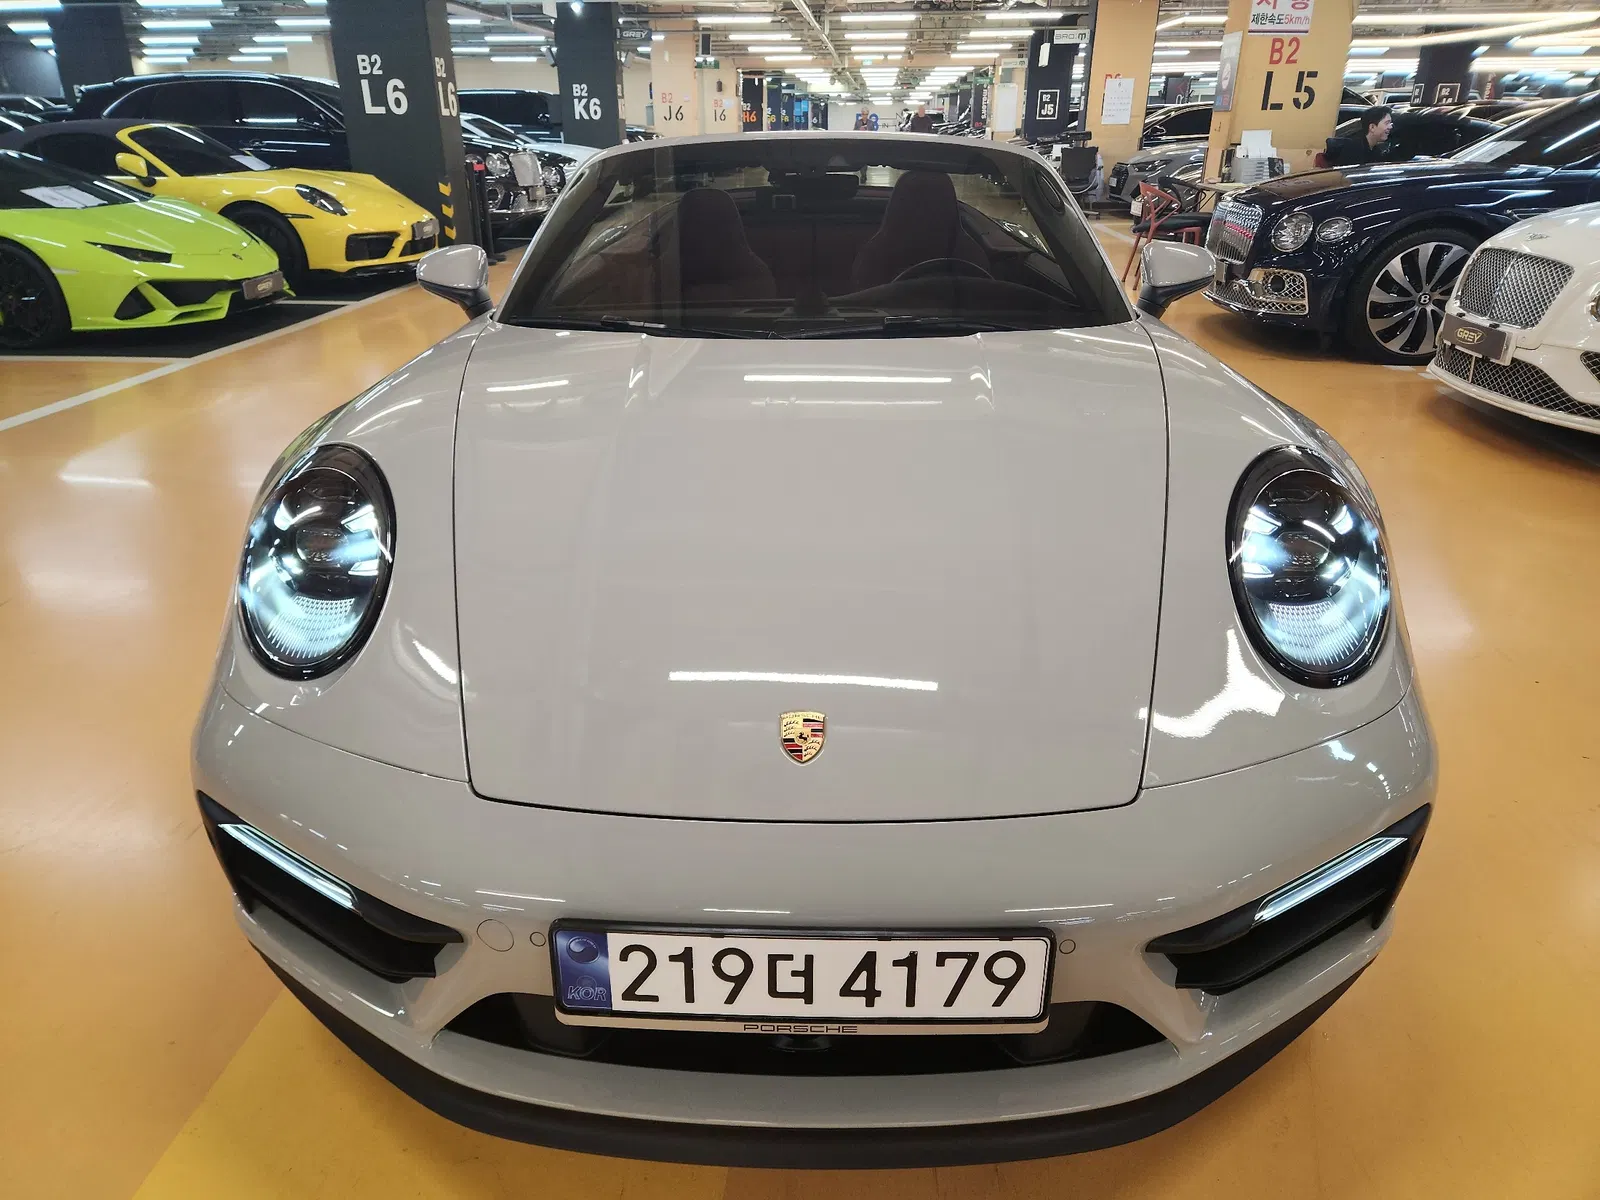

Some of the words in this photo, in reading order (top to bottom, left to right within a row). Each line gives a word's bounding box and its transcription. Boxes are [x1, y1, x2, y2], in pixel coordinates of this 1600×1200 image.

[622, 30, 648, 38] GREY
[1269, 37, 1301, 65] B2
[357, 54, 383, 74] B2
[435, 57, 446, 77] B2
[361, 78, 408, 115] L6
[572, 84, 588, 96] B2
[661, 92, 673, 104] B2
[1042, 94, 1051, 102] B2
[1261, 71, 1318, 110] L5
[438, 81, 457, 117] L6
[713, 99, 723, 108] B2
[742, 103, 751, 111] B2
[573, 98, 602, 120] K6
[663, 105, 684, 121] J6
[743, 111, 757, 122] H6
[1041, 104, 1054, 116] J5
[1457, 327, 1482, 344] GREY
[619, 944, 813, 1004] 219더
[839, 950, 1026, 1008] 4179
[567, 985, 607, 1002] KOR
[744, 1024, 858, 1033] PORSCHE
